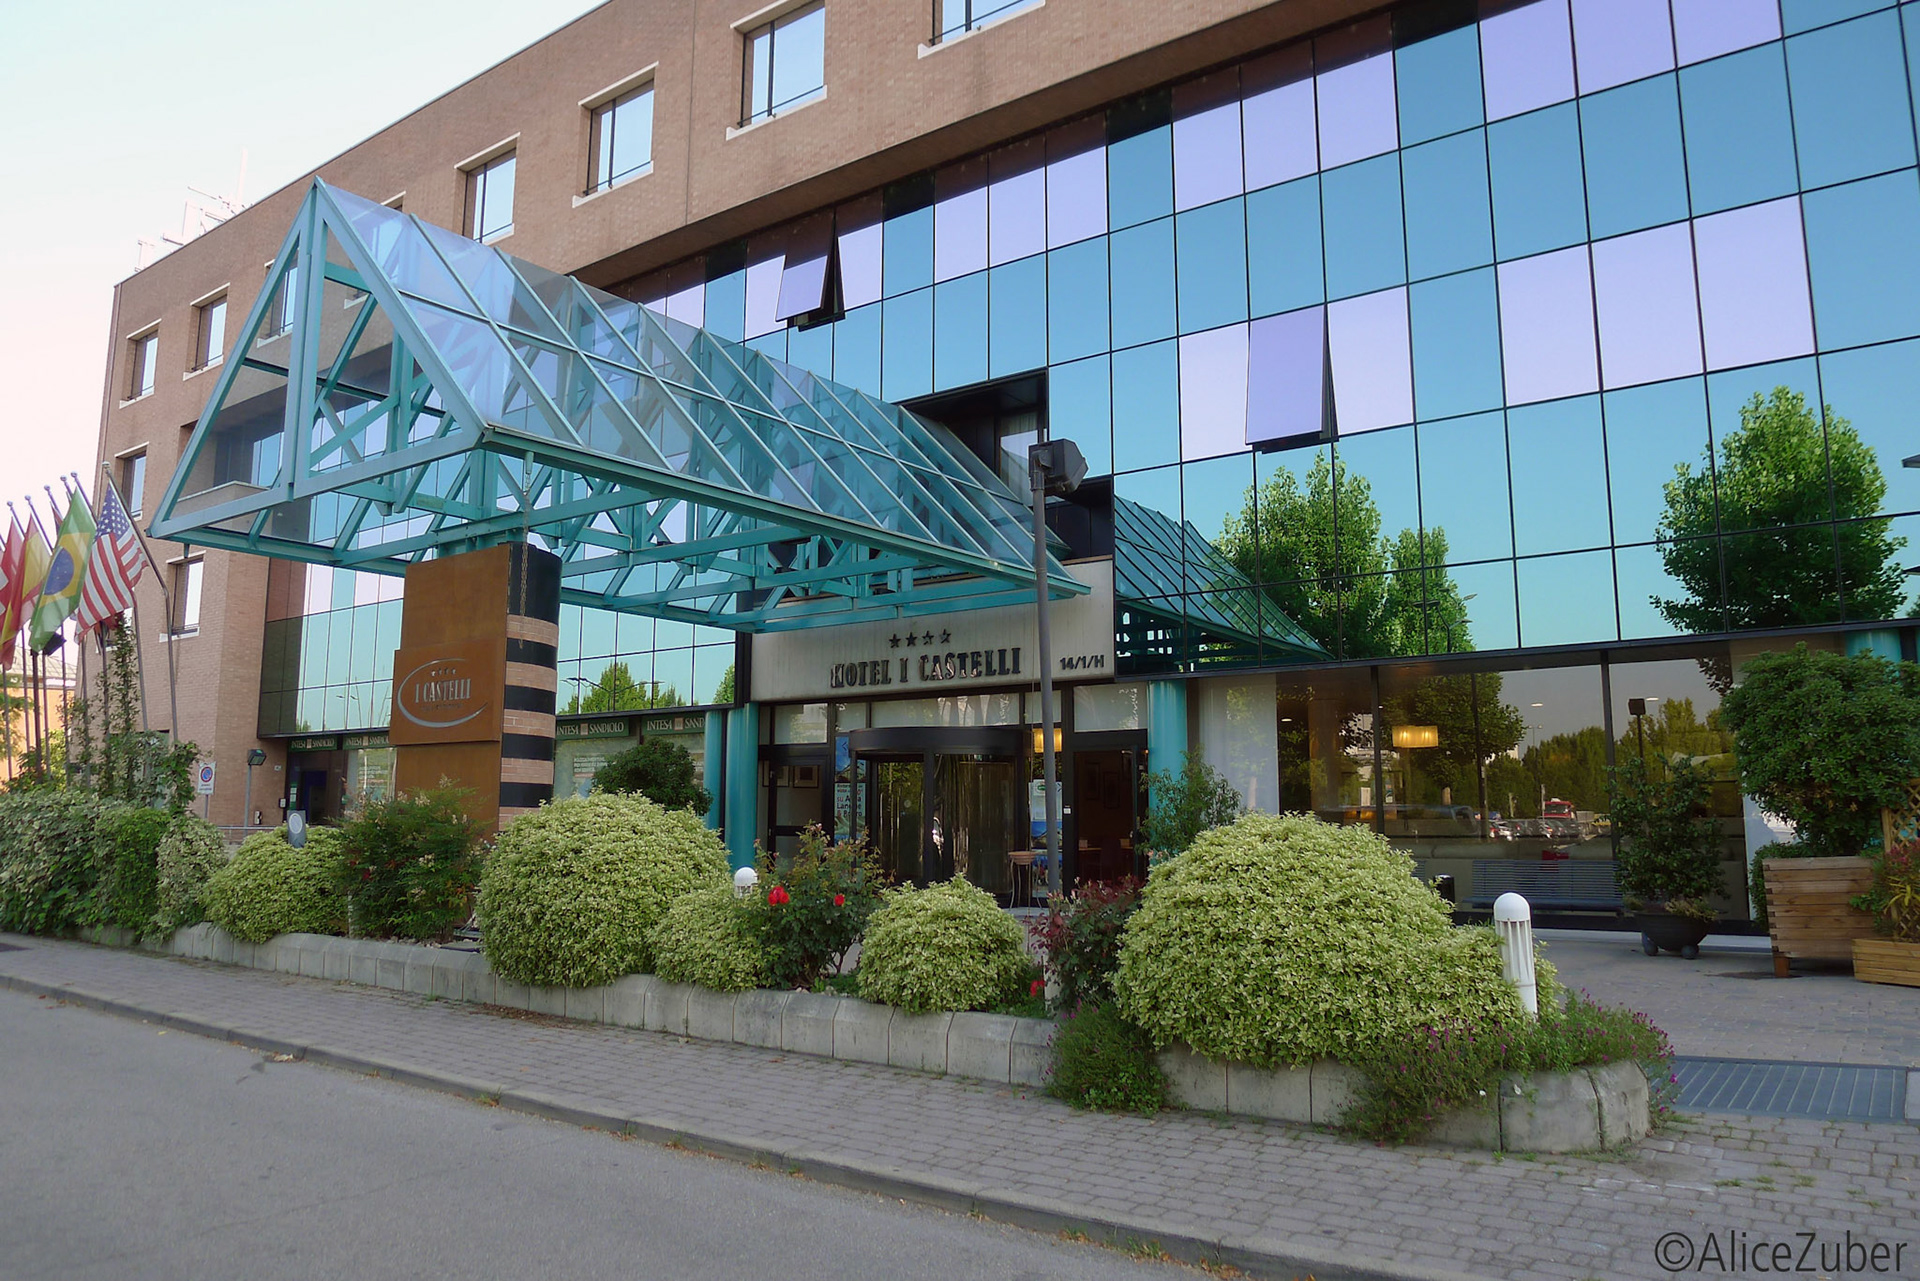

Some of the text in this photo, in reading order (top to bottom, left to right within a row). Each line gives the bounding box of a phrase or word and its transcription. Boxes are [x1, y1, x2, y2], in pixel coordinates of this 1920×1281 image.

[830, 647, 1021, 688] HOTEL I CASTELLI
[1059, 654, 1105, 670] 14/1/H
[423, 678, 471, 702] CASTELLI
[556, 722, 624, 736] INTESA SANPAOLO
[647, 717, 706, 731] INTESA SANP
